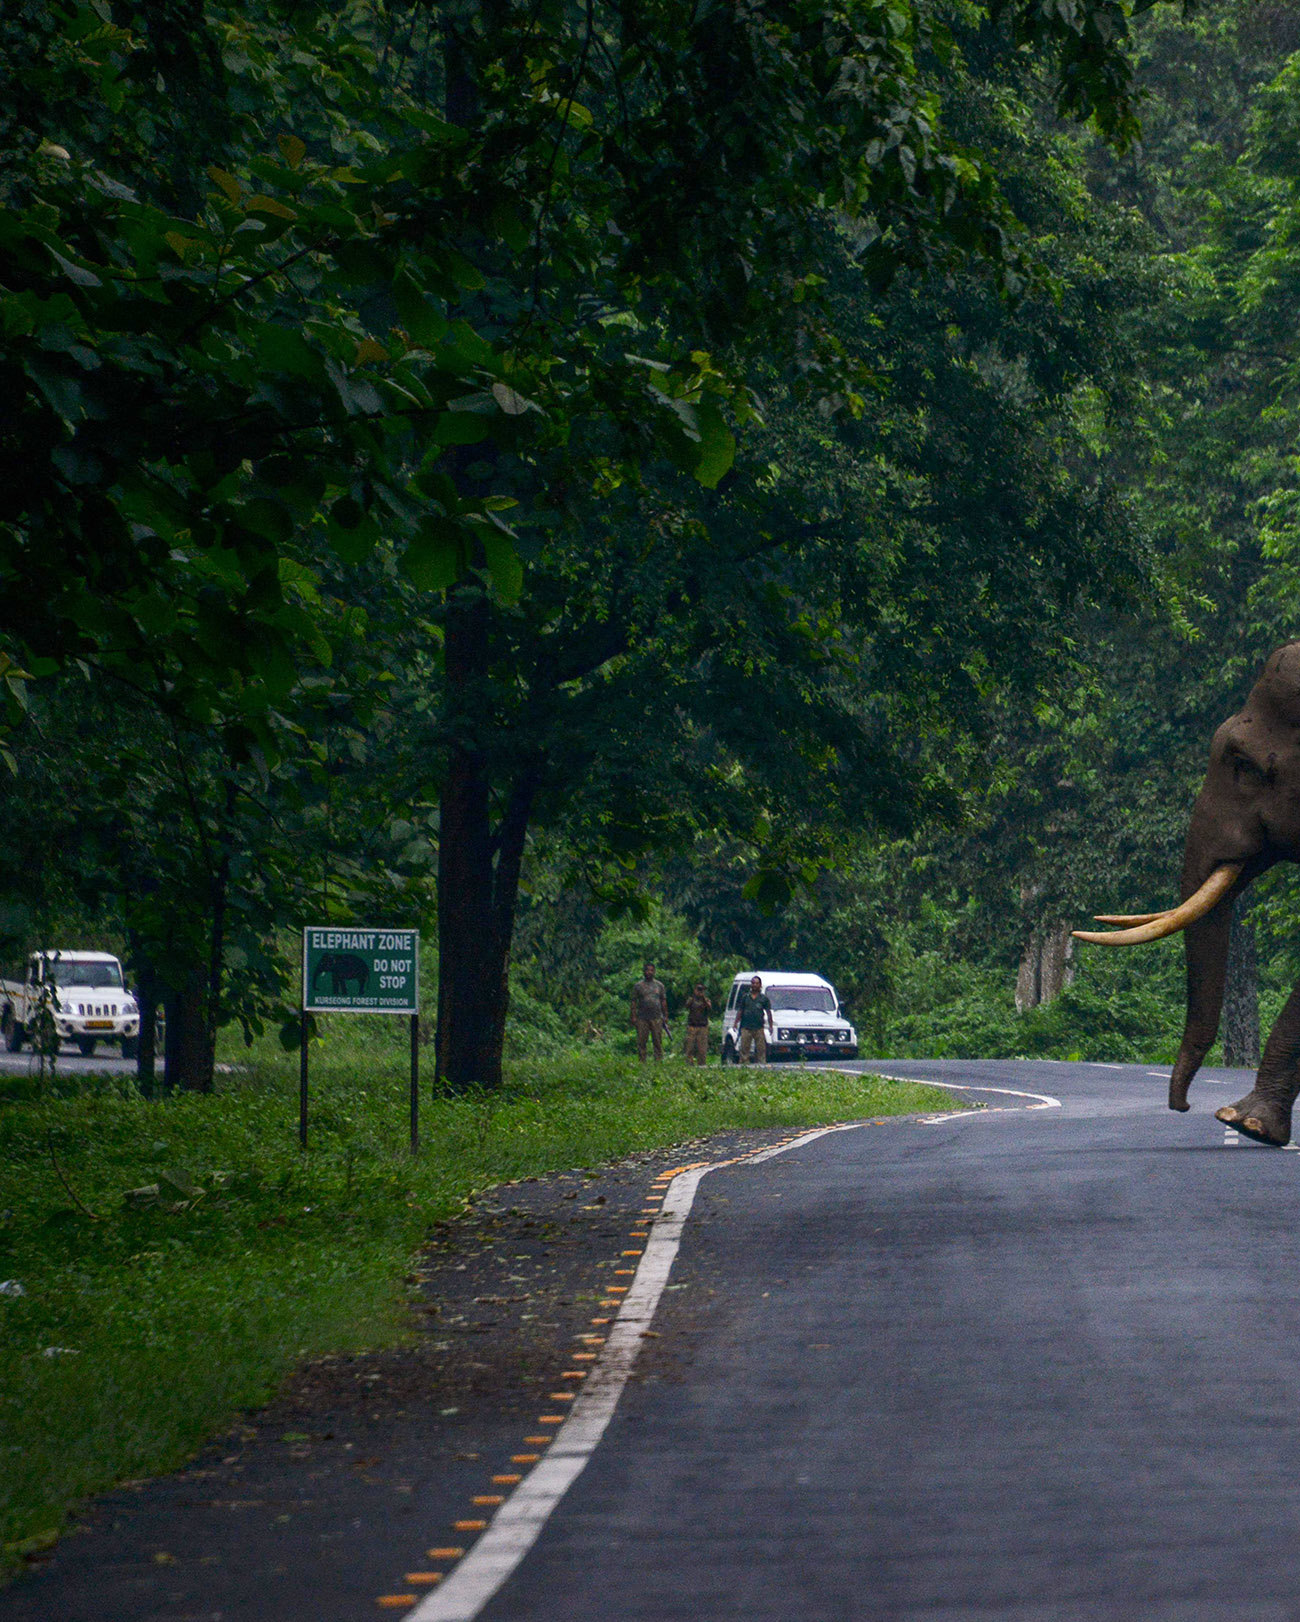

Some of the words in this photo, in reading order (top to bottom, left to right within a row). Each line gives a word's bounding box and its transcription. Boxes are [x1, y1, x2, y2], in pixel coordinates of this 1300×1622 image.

[312, 933, 375, 949] ELEPHANT
[378, 935, 411, 950] ZONE
[374, 959, 388, 972] DO
[391, 960, 411, 972] NOT
[380, 976, 406, 988] STOP
[352, 997, 378, 1005] FOREST
[379, 998, 409, 1006] DIVISION
